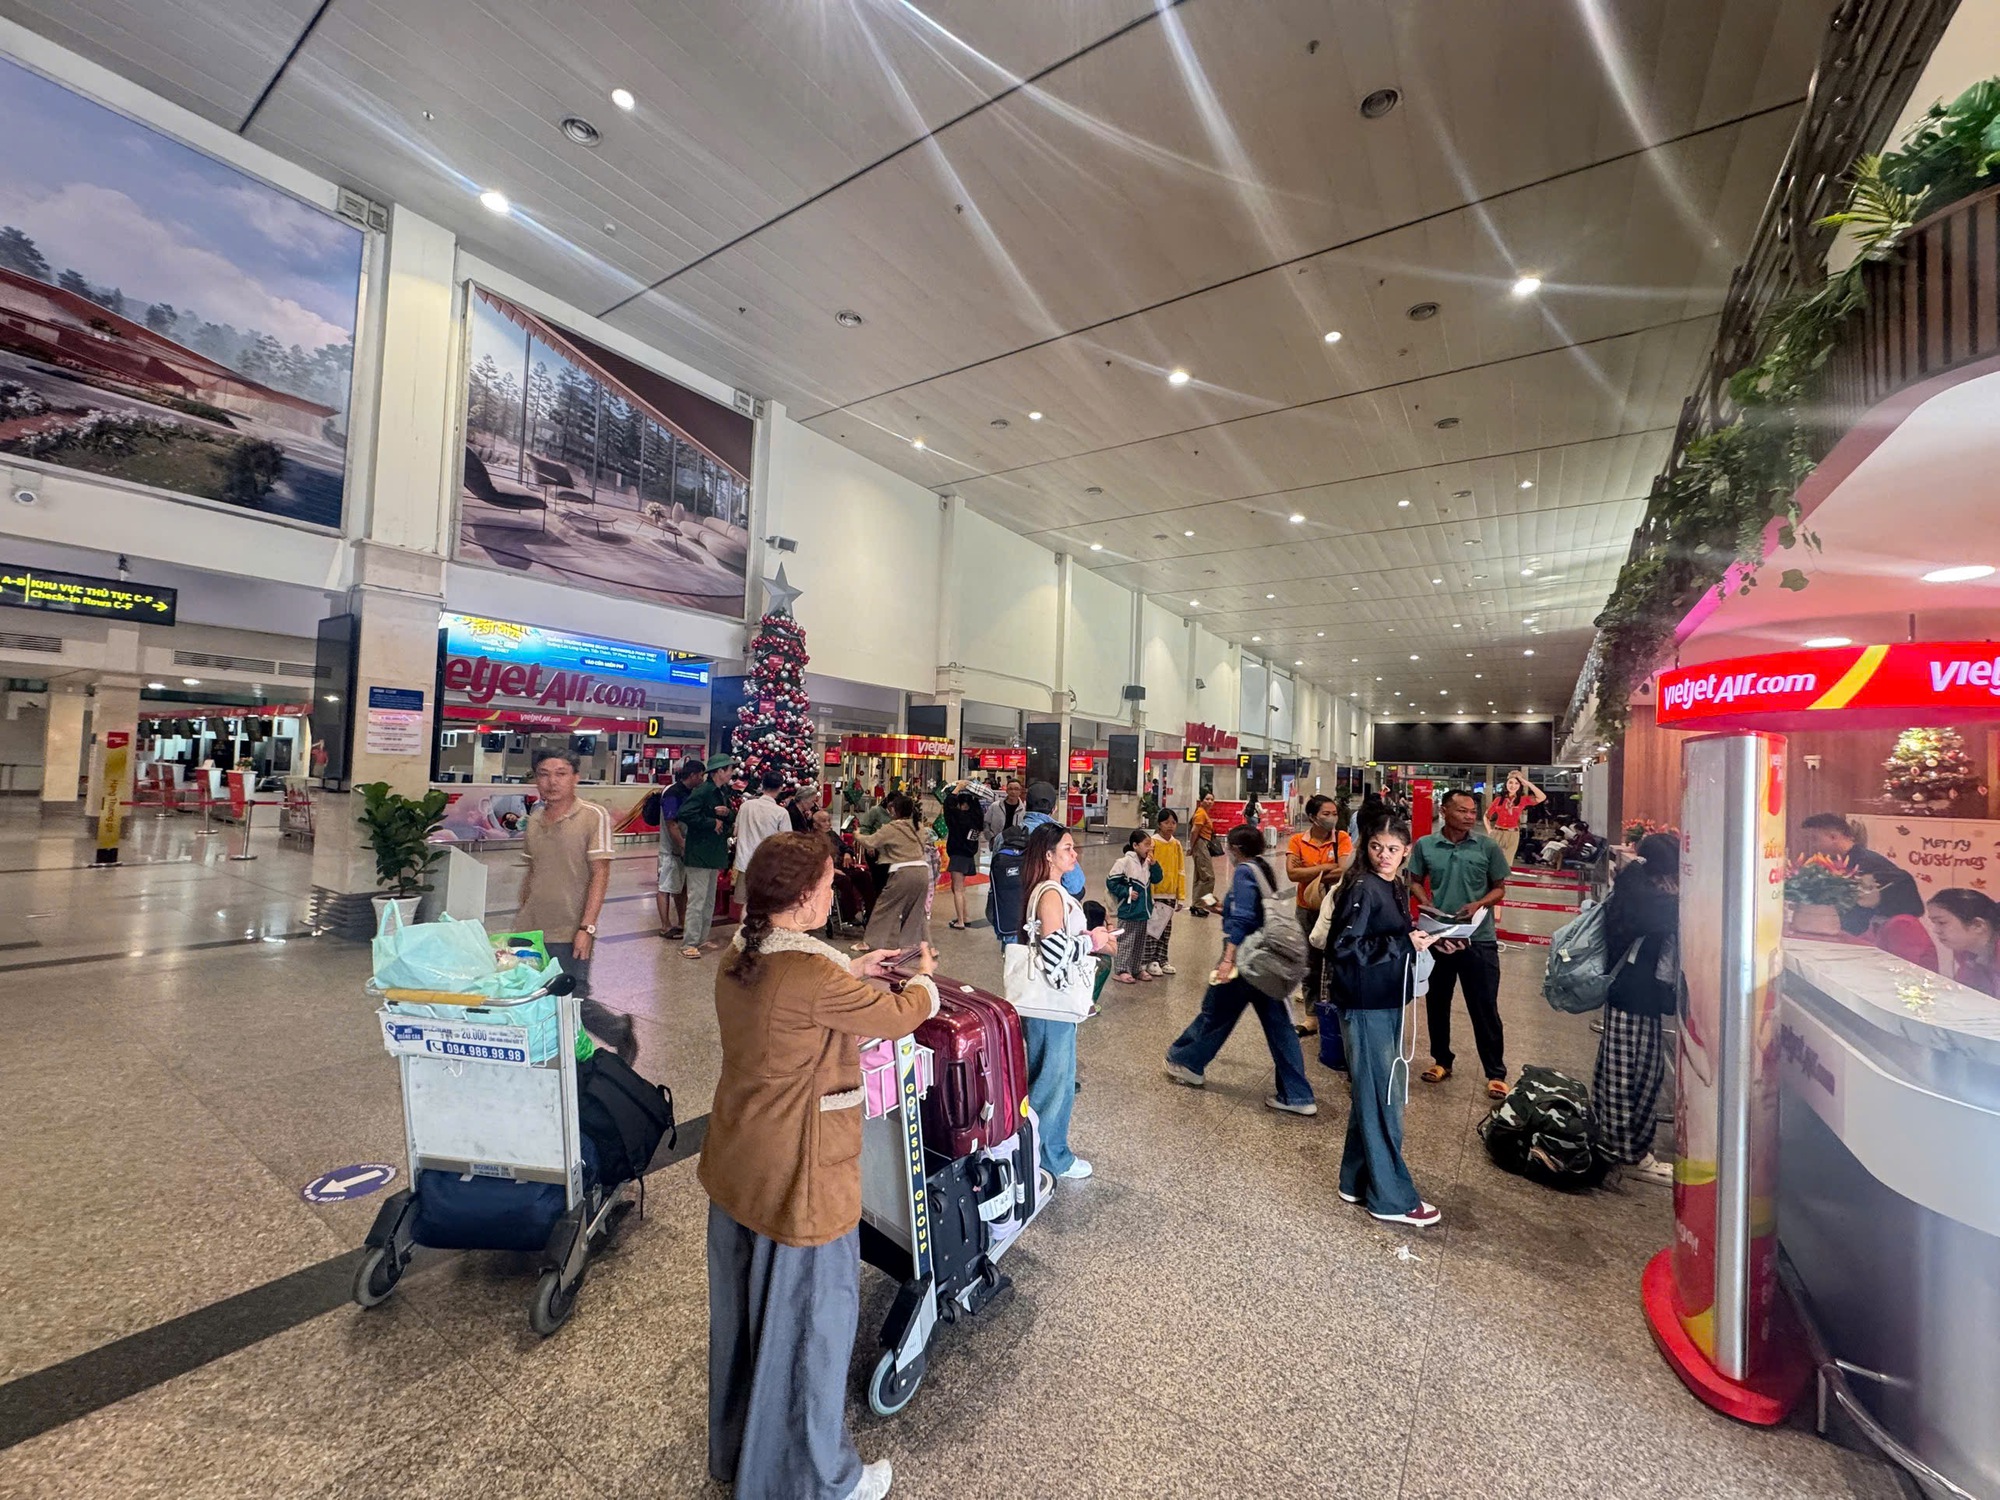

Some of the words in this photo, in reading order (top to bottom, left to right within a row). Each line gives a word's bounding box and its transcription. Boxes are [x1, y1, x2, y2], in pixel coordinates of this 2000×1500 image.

[2, 575, 26, 586] A-B
[30, 589, 81, 603] Check-in
[83, 596, 112, 607] Rows
[113, 602, 133, 610] C-F
[31, 579, 58, 590] KHU
[60, 583, 84, 595] VỰC
[86, 586, 109, 598] THỦ
[111, 590, 133, 602] TỤC
[134, 594, 153, 604] C-F
[649, 719, 659, 736] D
[1186, 747, 1197, 761] E
[1240, 755, 1249, 767] F
[1920, 836, 1971, 852] Merry
[446, 1043, 521, 1061] 094.986.98.98
[905, 1083, 922, 1175] GOLDSUN
[914, 1189, 927, 1254] GROUP
